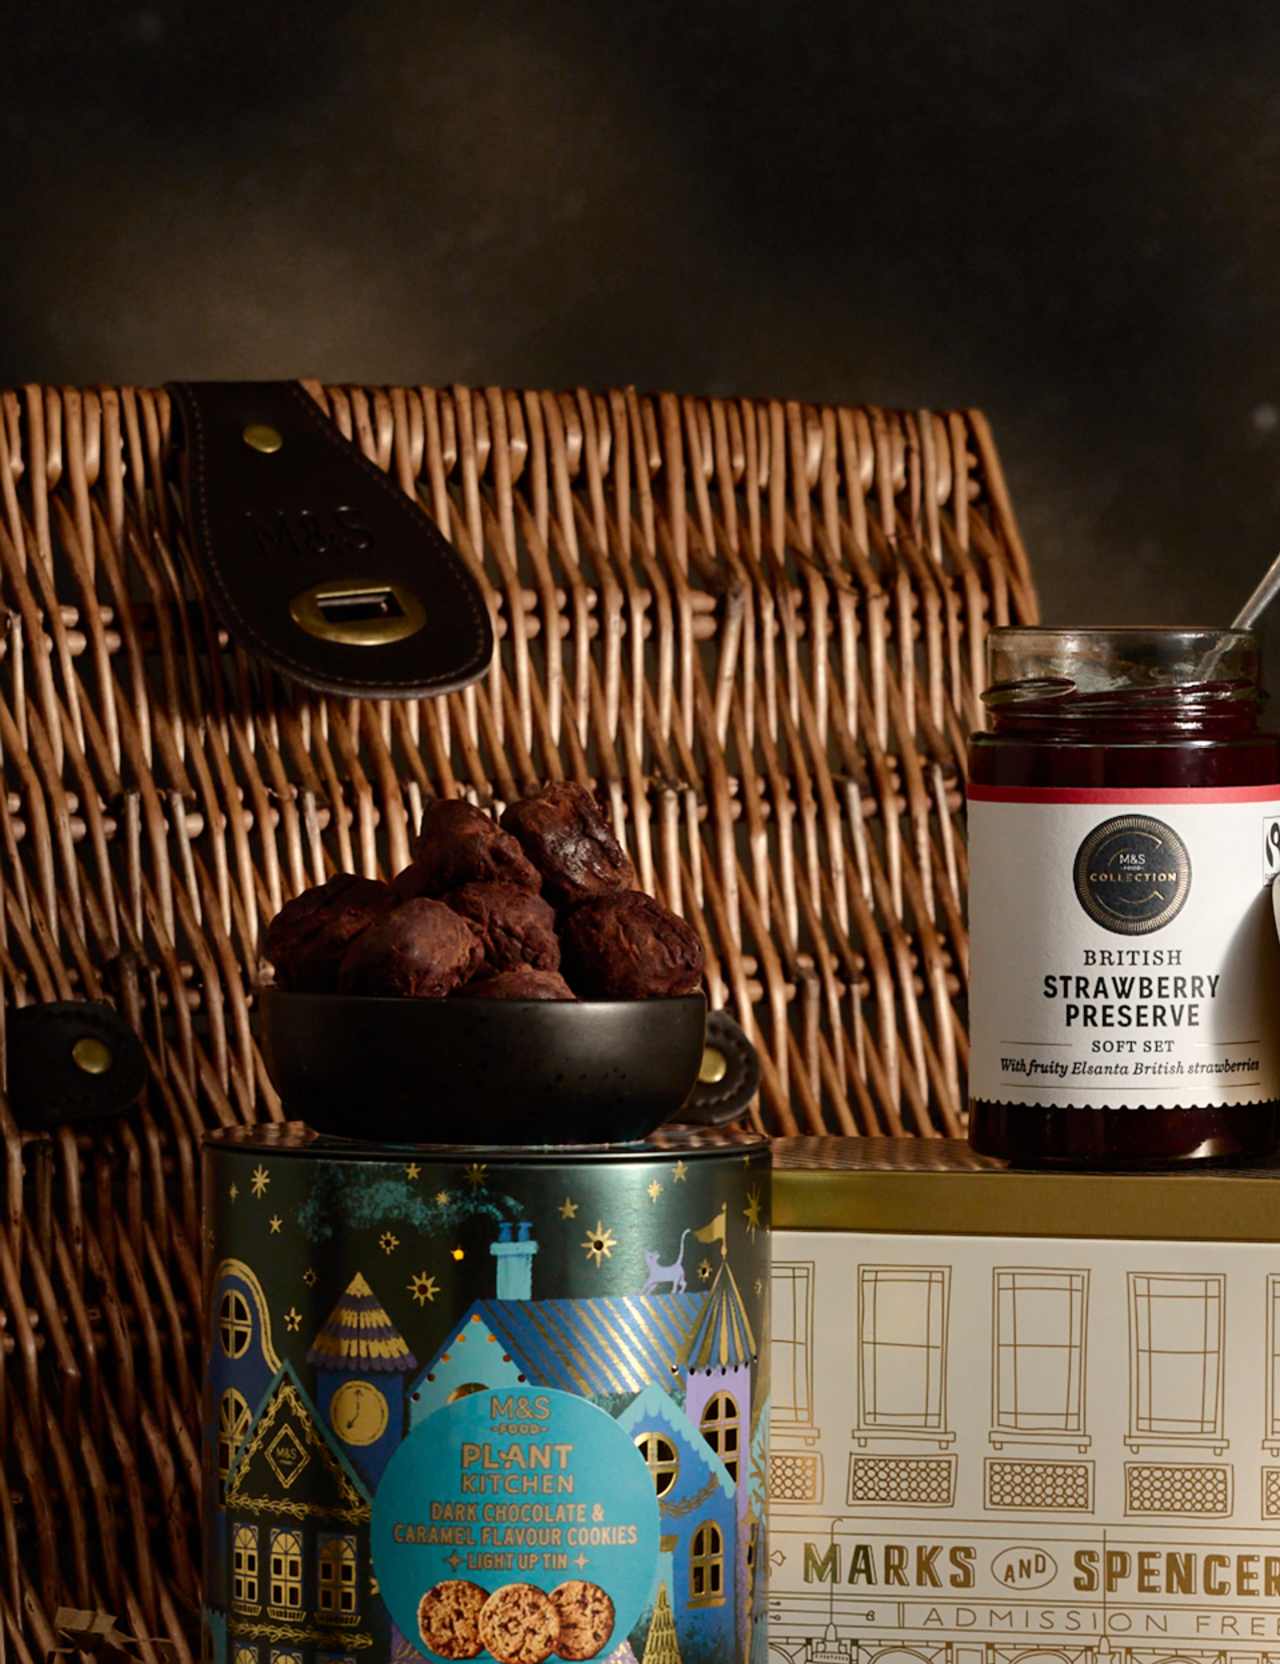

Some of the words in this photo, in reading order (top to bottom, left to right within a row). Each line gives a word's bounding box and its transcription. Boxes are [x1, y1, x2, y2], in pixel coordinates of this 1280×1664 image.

[1119, 854, 1146, 864] M&S
[1089, 872, 1177, 882] COLLECTION
[1083, 950, 1183, 966] BRITISH
[1043, 974, 1221, 999] STRAWBERRY
[1065, 1003, 1200, 1027] PRESERVE
[1092, 1040, 1137, 1053] SOFT
[1143, 1040, 1176, 1053] SET
[1000, 1057, 1026, 1073] With
[1026, 1060, 1069, 1077] fruity
[1071, 1060, 1129, 1075] Elsanta
[1133, 1060, 1185, 1075] British
[1187, 1057, 1260, 1074] strawberries
[490, 1396, 551, 1420] M&S
[461, 1443, 574, 1470] PLANT
[461, 1474, 574, 1494] KITCHEN
[430, 1503, 479, 1522] DARK
[483, 1503, 587, 1523] CHOCOLATE
[591, 1503, 605, 1522] &
[393, 1522, 475, 1546] CARAMEL
[481, 1526, 561, 1547] FLAVOUR
[567, 1525, 638, 1545] COOKIES
[467, 1552, 514, 1571] LIGHT
[517, 1552, 539, 1570] UP
[543, 1552, 568, 1570] TIN
[802, 1541, 977, 1588] MARKS
[1003, 1553, 1047, 1583] AND
[922, 1606, 1169, 1634] ADMISSION
